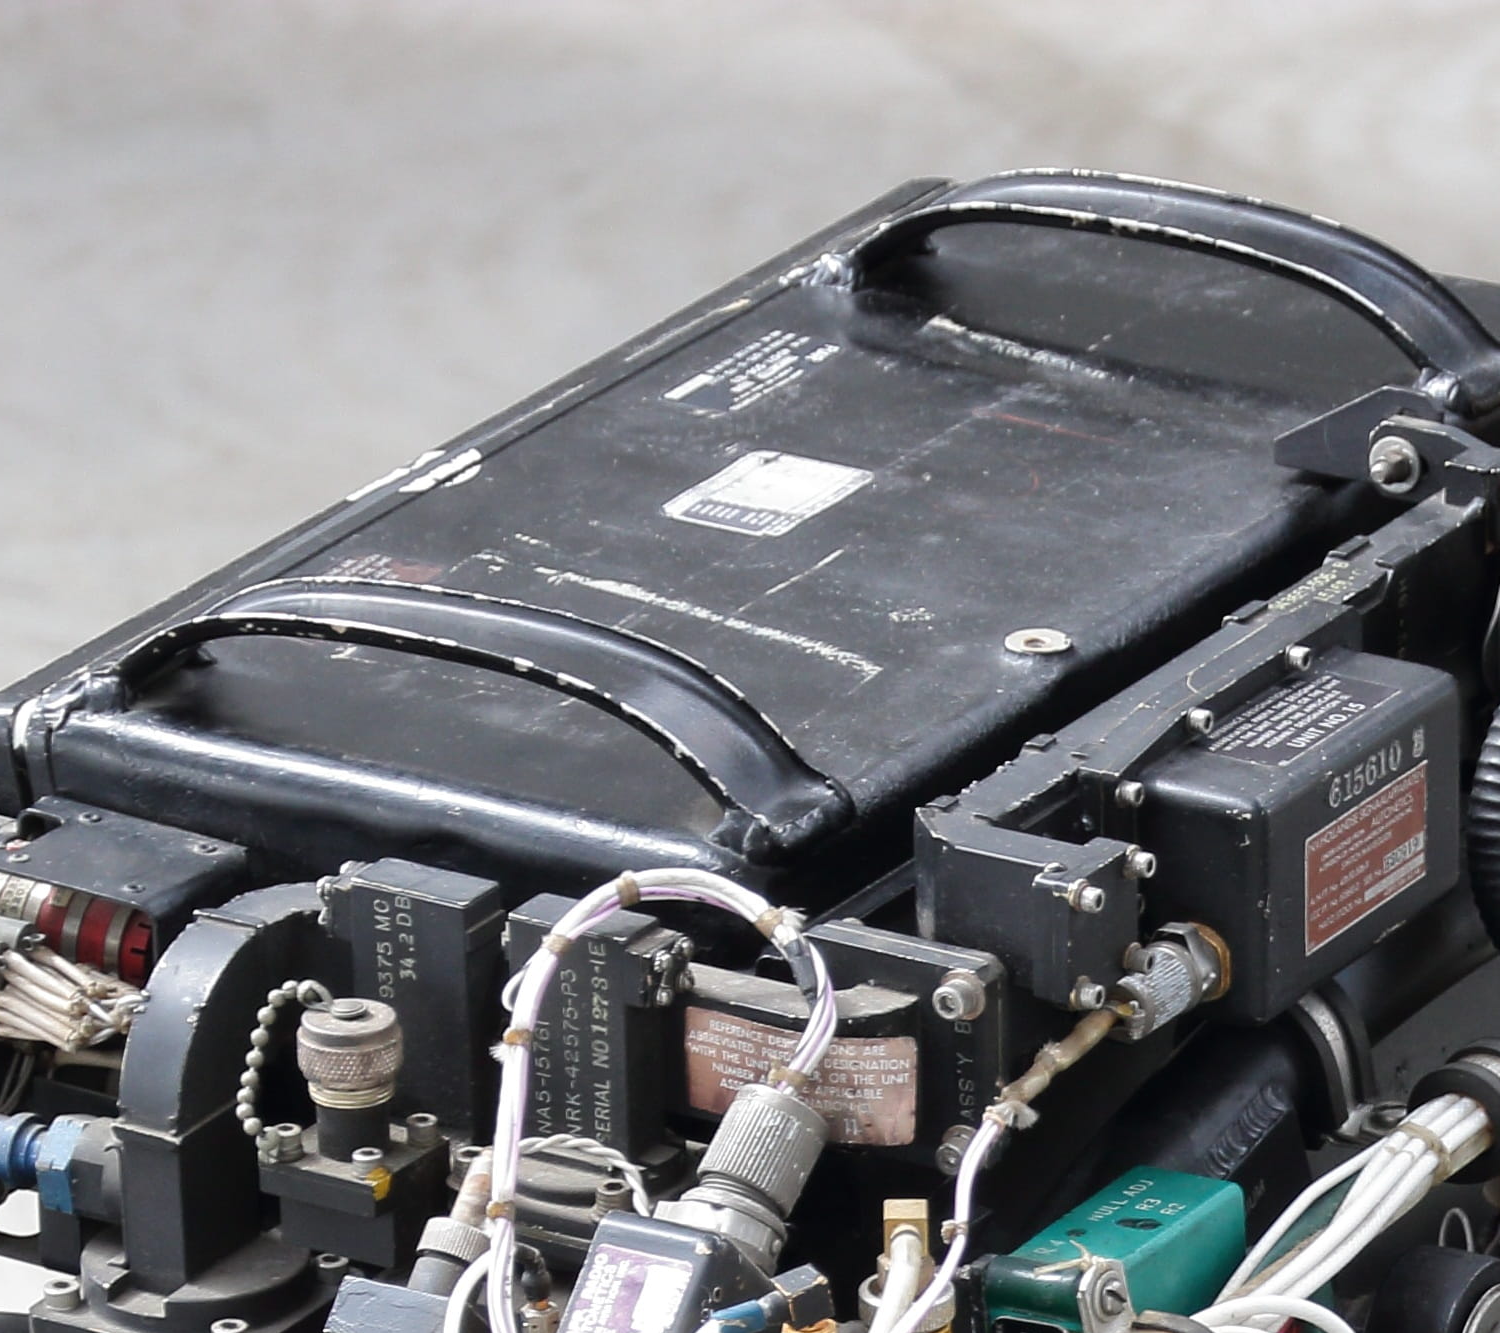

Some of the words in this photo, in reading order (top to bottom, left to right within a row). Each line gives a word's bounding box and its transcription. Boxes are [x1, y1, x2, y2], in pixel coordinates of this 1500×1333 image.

[1288, 727, 1324, 747] UNIT
[395, 891, 413, 926] DB
[377, 942, 393, 997] 9375
[721, 1051, 741, 1064] THE
[881, 1073, 911, 1083] UNIT
[1133, 1190, 1161, 1218] R3
[579, 1250, 610, 1302] RADIO
